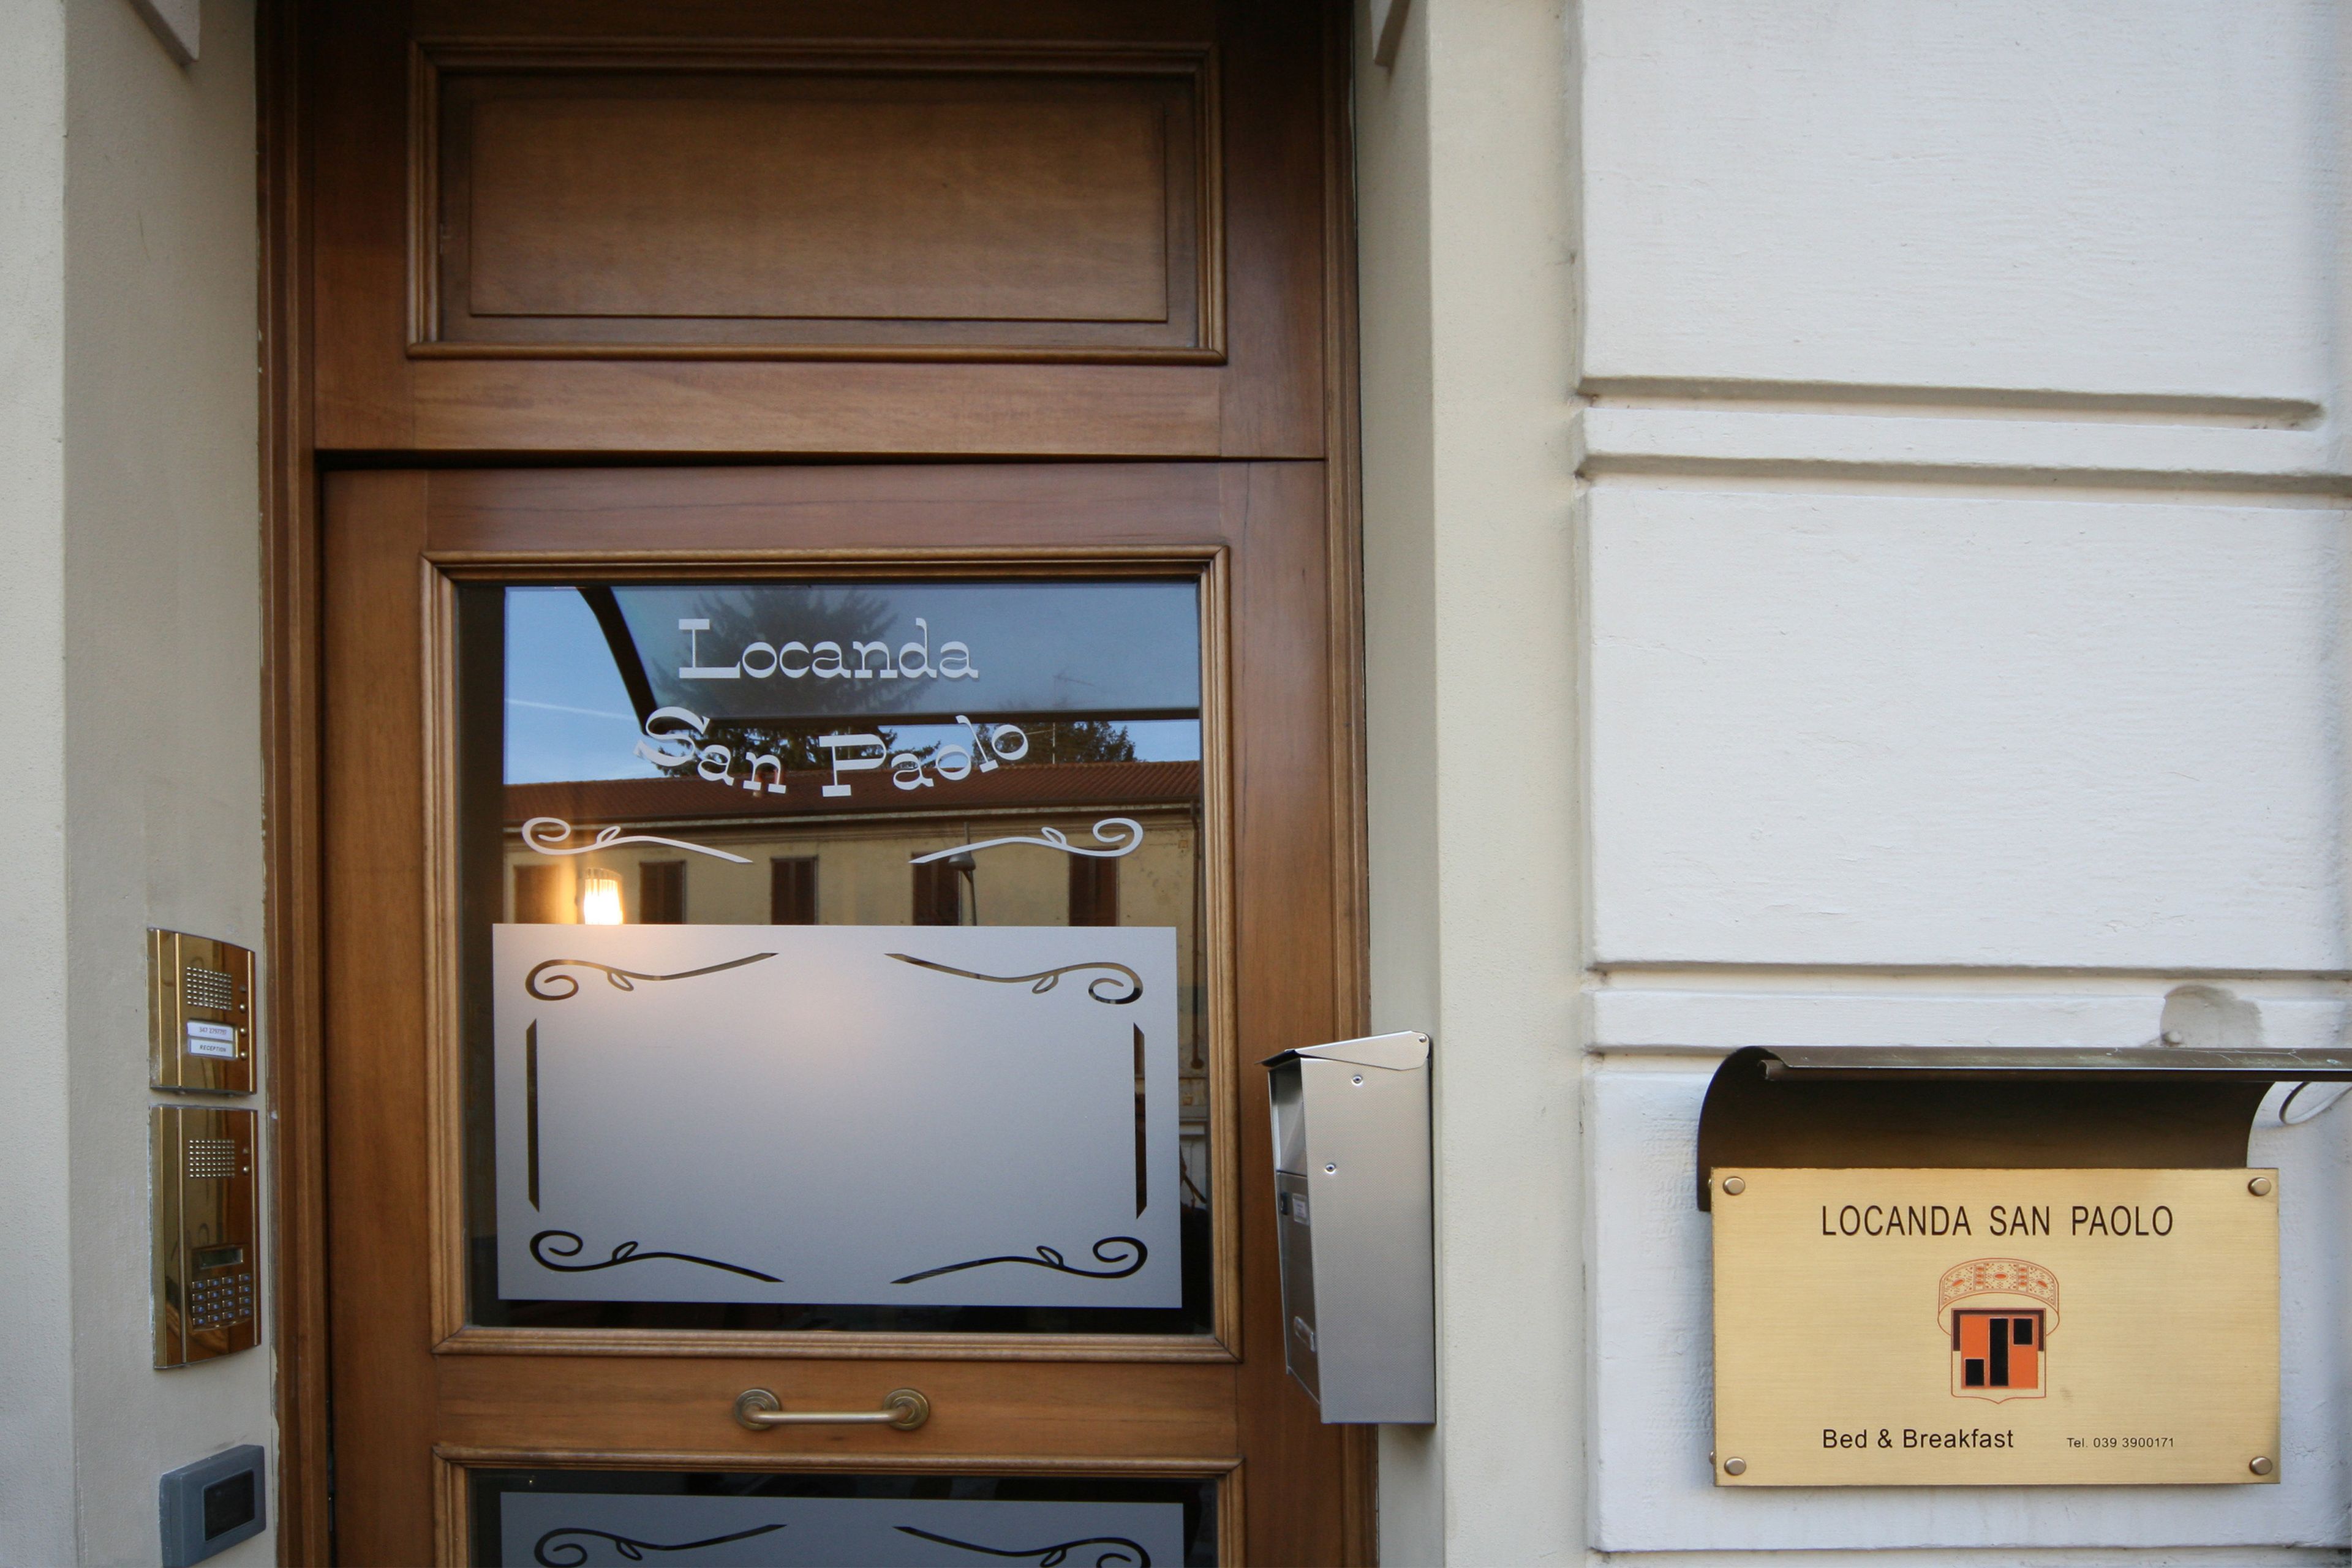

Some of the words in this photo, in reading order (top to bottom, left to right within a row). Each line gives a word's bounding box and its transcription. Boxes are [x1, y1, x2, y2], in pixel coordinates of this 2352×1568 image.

[678, 617, 978, 678] Locanda
[633, 706, 786, 794] San
[819, 714, 1028, 796] Paolo
[1822, 1205, 1972, 1236] LOCANDA
[1989, 1205, 2050, 1236] SAN
[2072, 1205, 2174, 1236] PAOLO
[1822, 1428, 1868, 1449] Bed
[1877, 1429, 1893, 1449] &
[1902, 1428, 2015, 1449] Breakfast
[2067, 1437, 2089, 1448] Tel.
[2093, 1437, 2118, 1448] 039
[2122, 1437, 2175, 1448] 3900171
